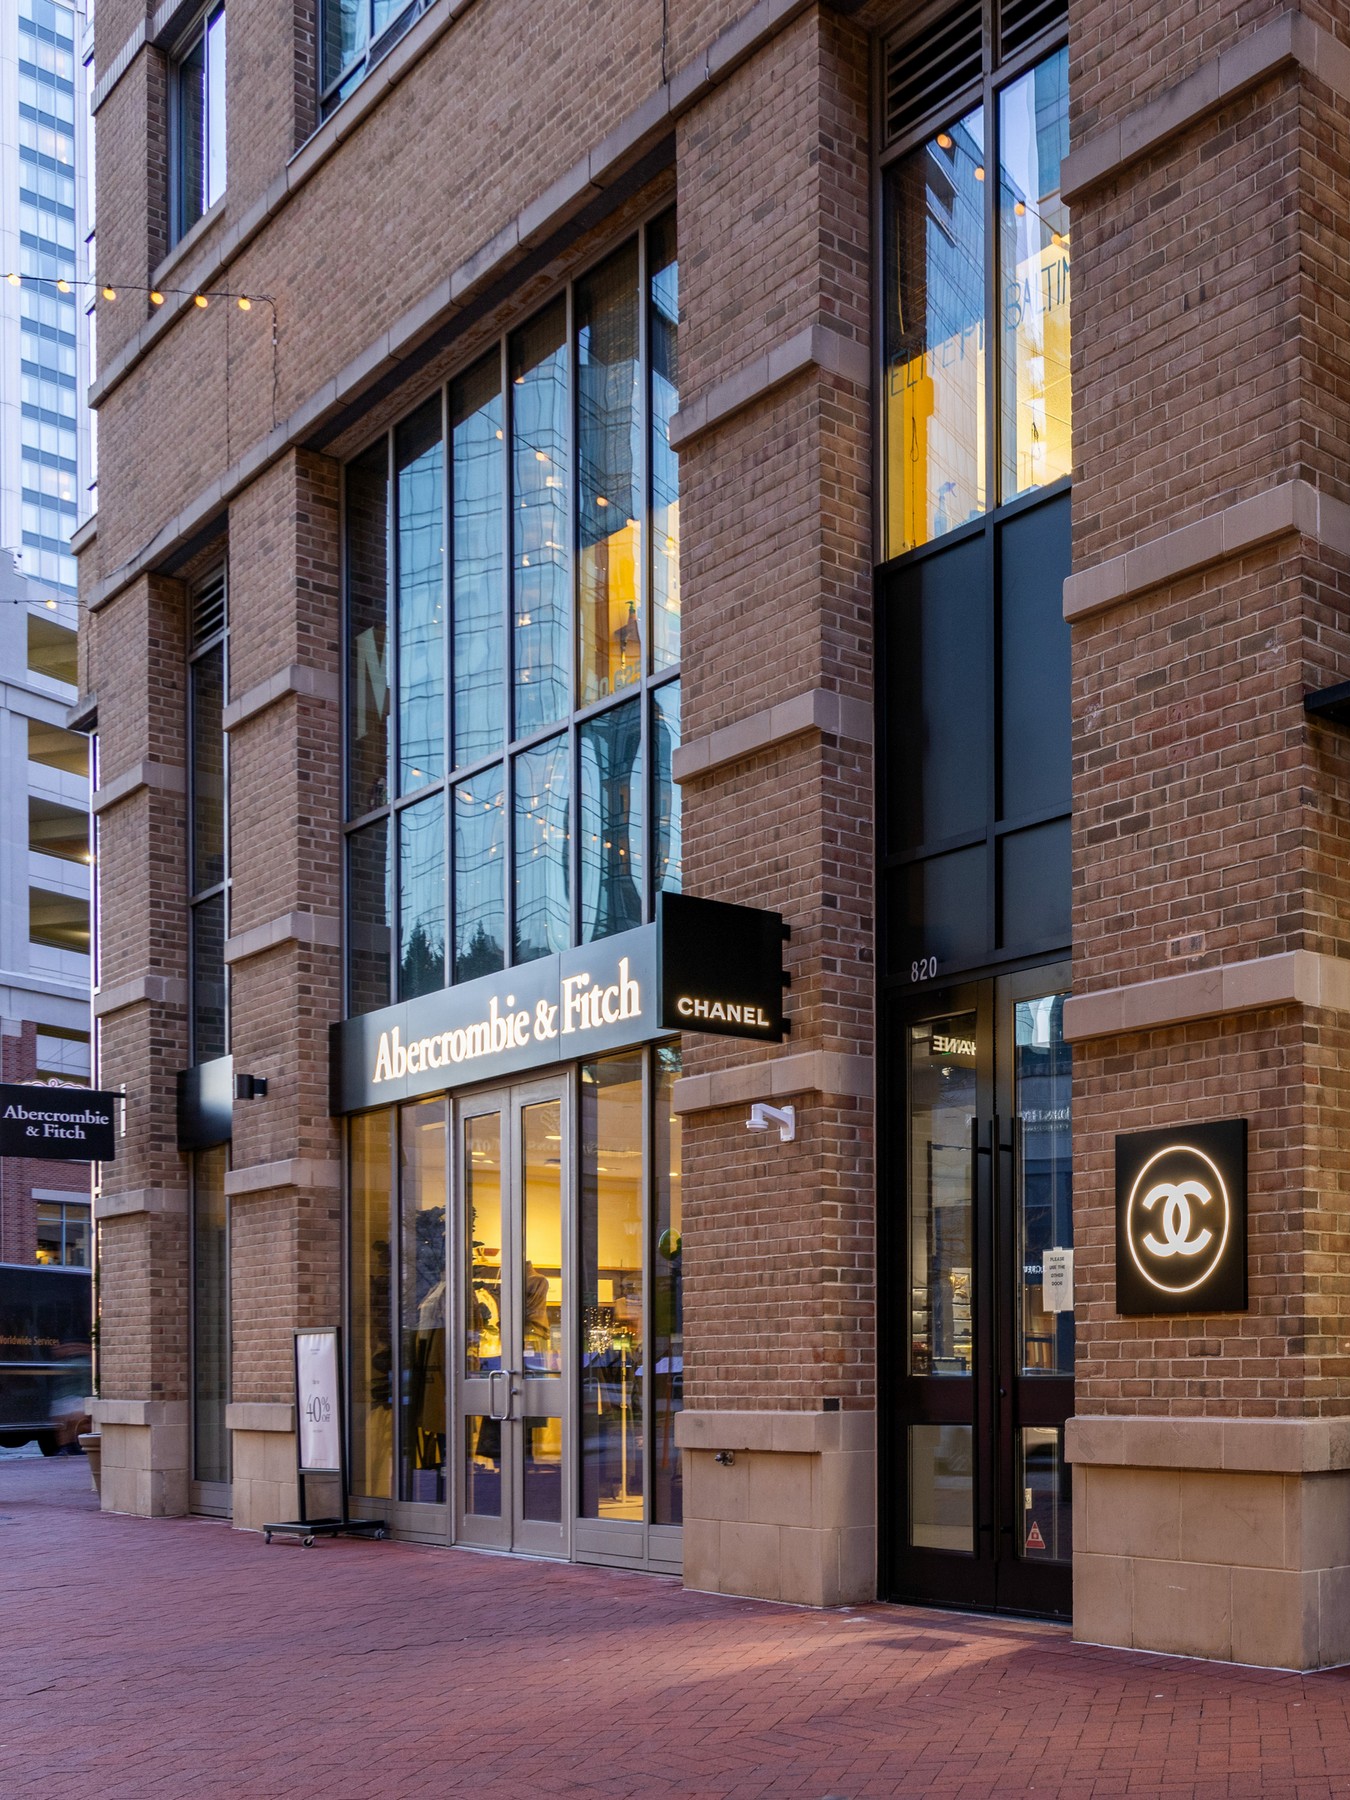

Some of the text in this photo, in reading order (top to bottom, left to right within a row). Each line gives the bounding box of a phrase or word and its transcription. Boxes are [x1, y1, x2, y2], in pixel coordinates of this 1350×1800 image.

[911, 956, 937, 982] 820
[372, 956, 642, 1084] Abercrombie & Fitch
[677, 997, 770, 1027] CHANEL
[2, 1104, 110, 1125] Abercrombie
[25, 1123, 87, 1139] & Fitch
